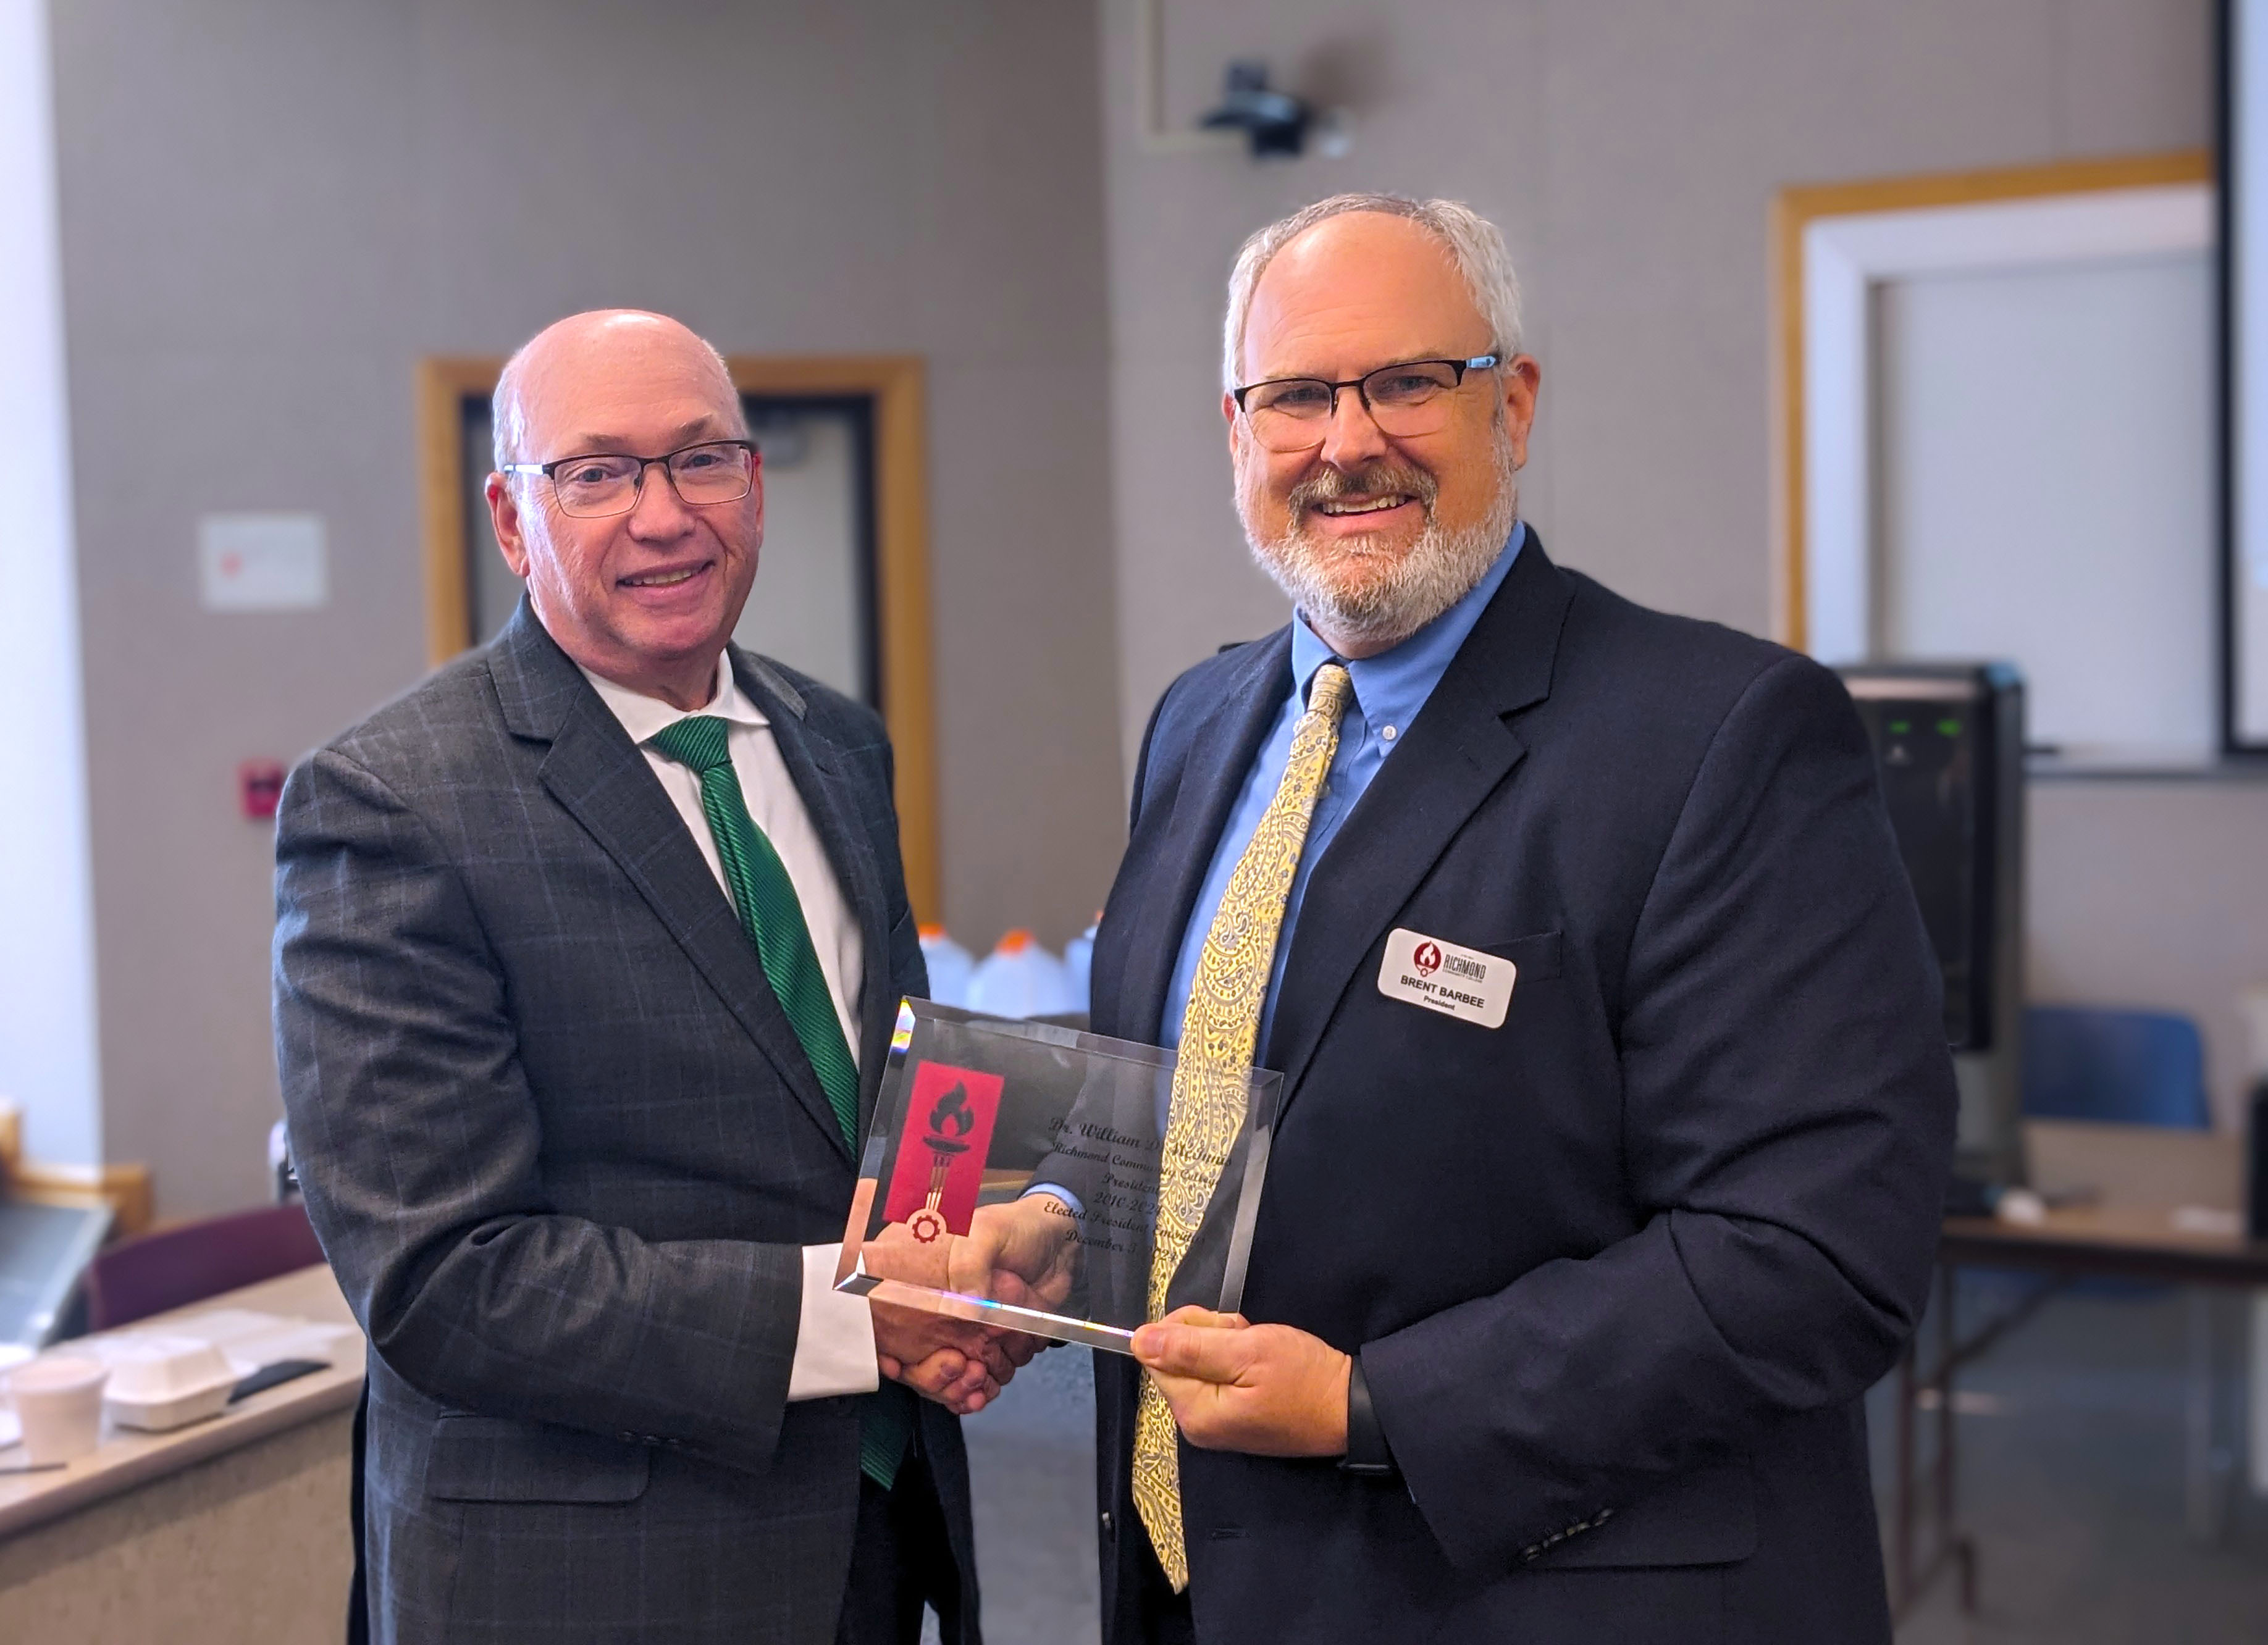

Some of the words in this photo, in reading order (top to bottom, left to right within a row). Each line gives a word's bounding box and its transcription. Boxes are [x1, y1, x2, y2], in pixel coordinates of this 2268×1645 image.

[1443, 954, 1487, 979] RICHMOND
[1400, 974, 1438, 994] BRENT
[1439, 987, 1485, 1008] BARBEE
[1423, 995, 1455, 1011] President
[1048, 1117, 1073, 1134] Dr.
[1079, 1123, 1140, 1149] William
[1052, 1141, 1111, 1163] Richmond
[1044, 1200, 1088, 1220] Elected
[1090, 1211, 1149, 1233] President
[1065, 1229, 1124, 1253] December
